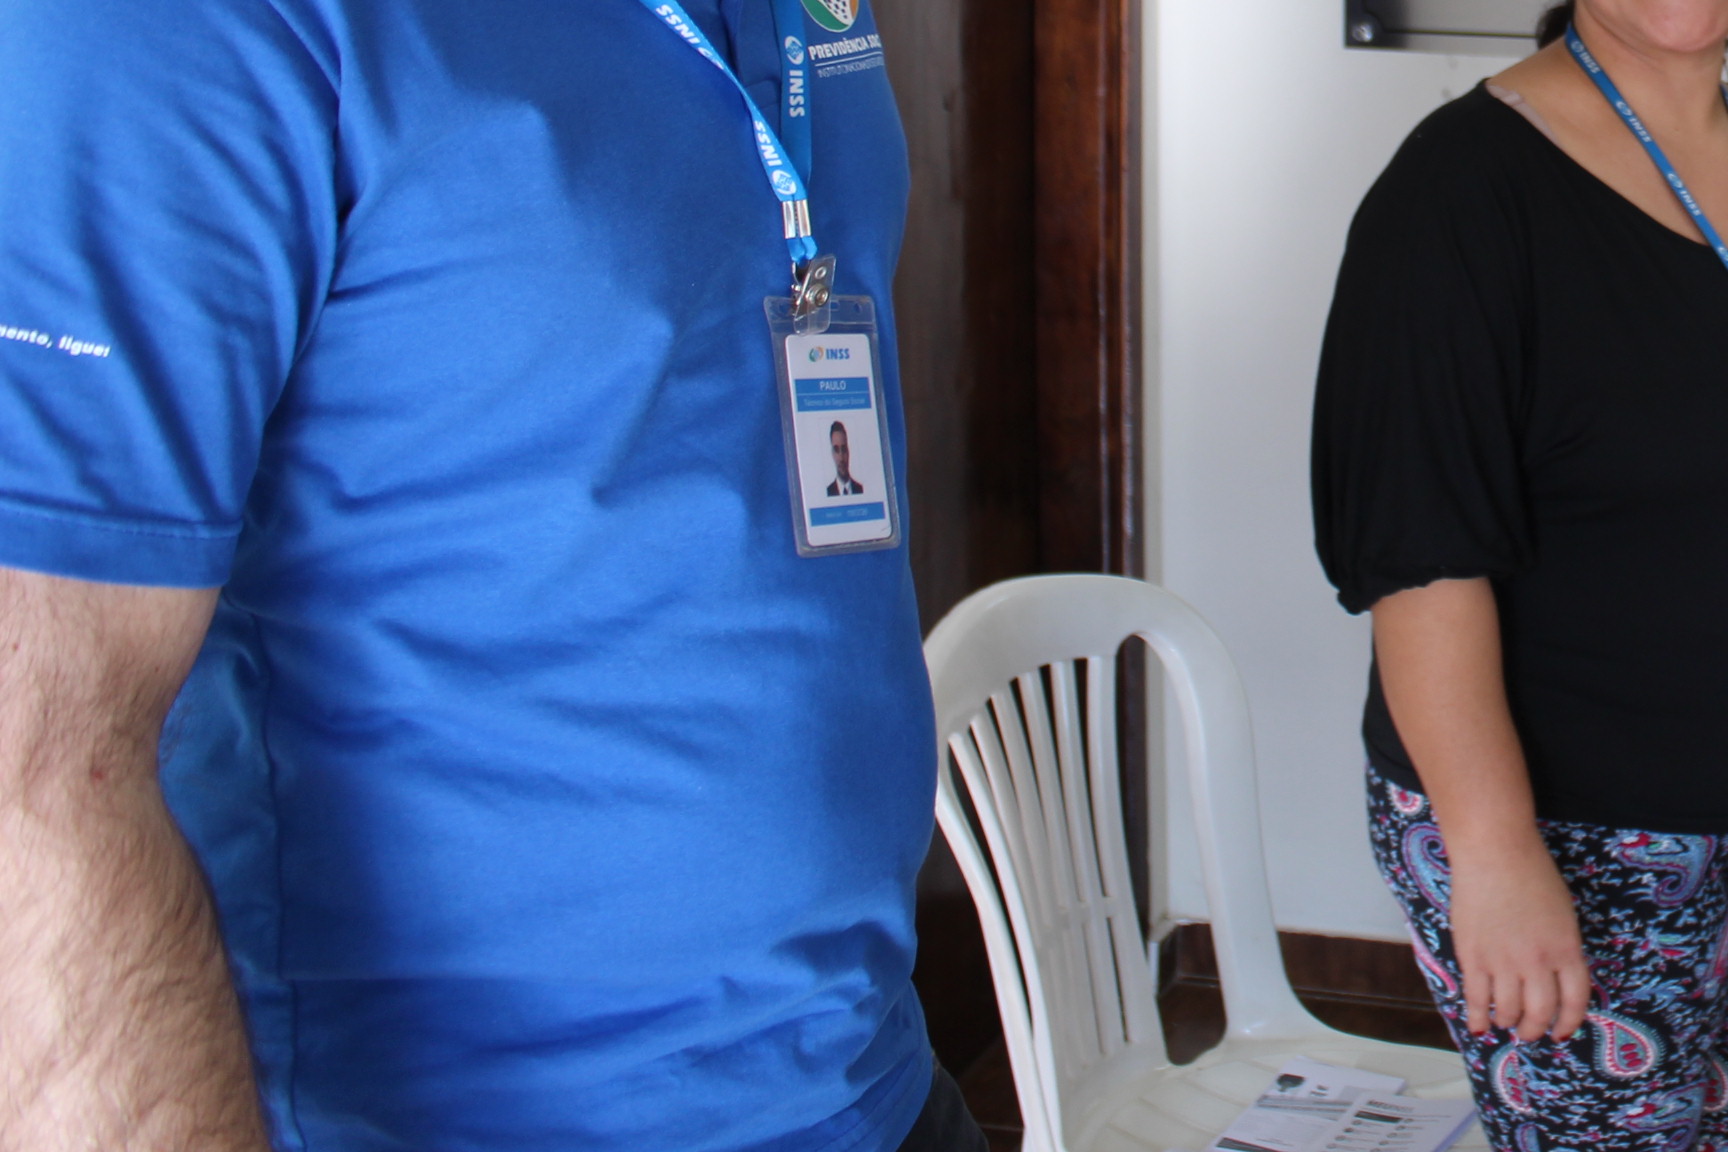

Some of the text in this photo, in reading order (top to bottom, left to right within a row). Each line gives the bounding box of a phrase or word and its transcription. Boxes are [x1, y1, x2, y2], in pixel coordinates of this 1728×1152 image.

[656, 4, 700, 44] INSS
[808, 36, 869, 61] PREVIDÊNCIA
[789, 70, 805, 117] INSS
[754, 120, 783, 167] INSS
[826, 348, 850, 361] INSS
[819, 380, 848, 392] PAULO
